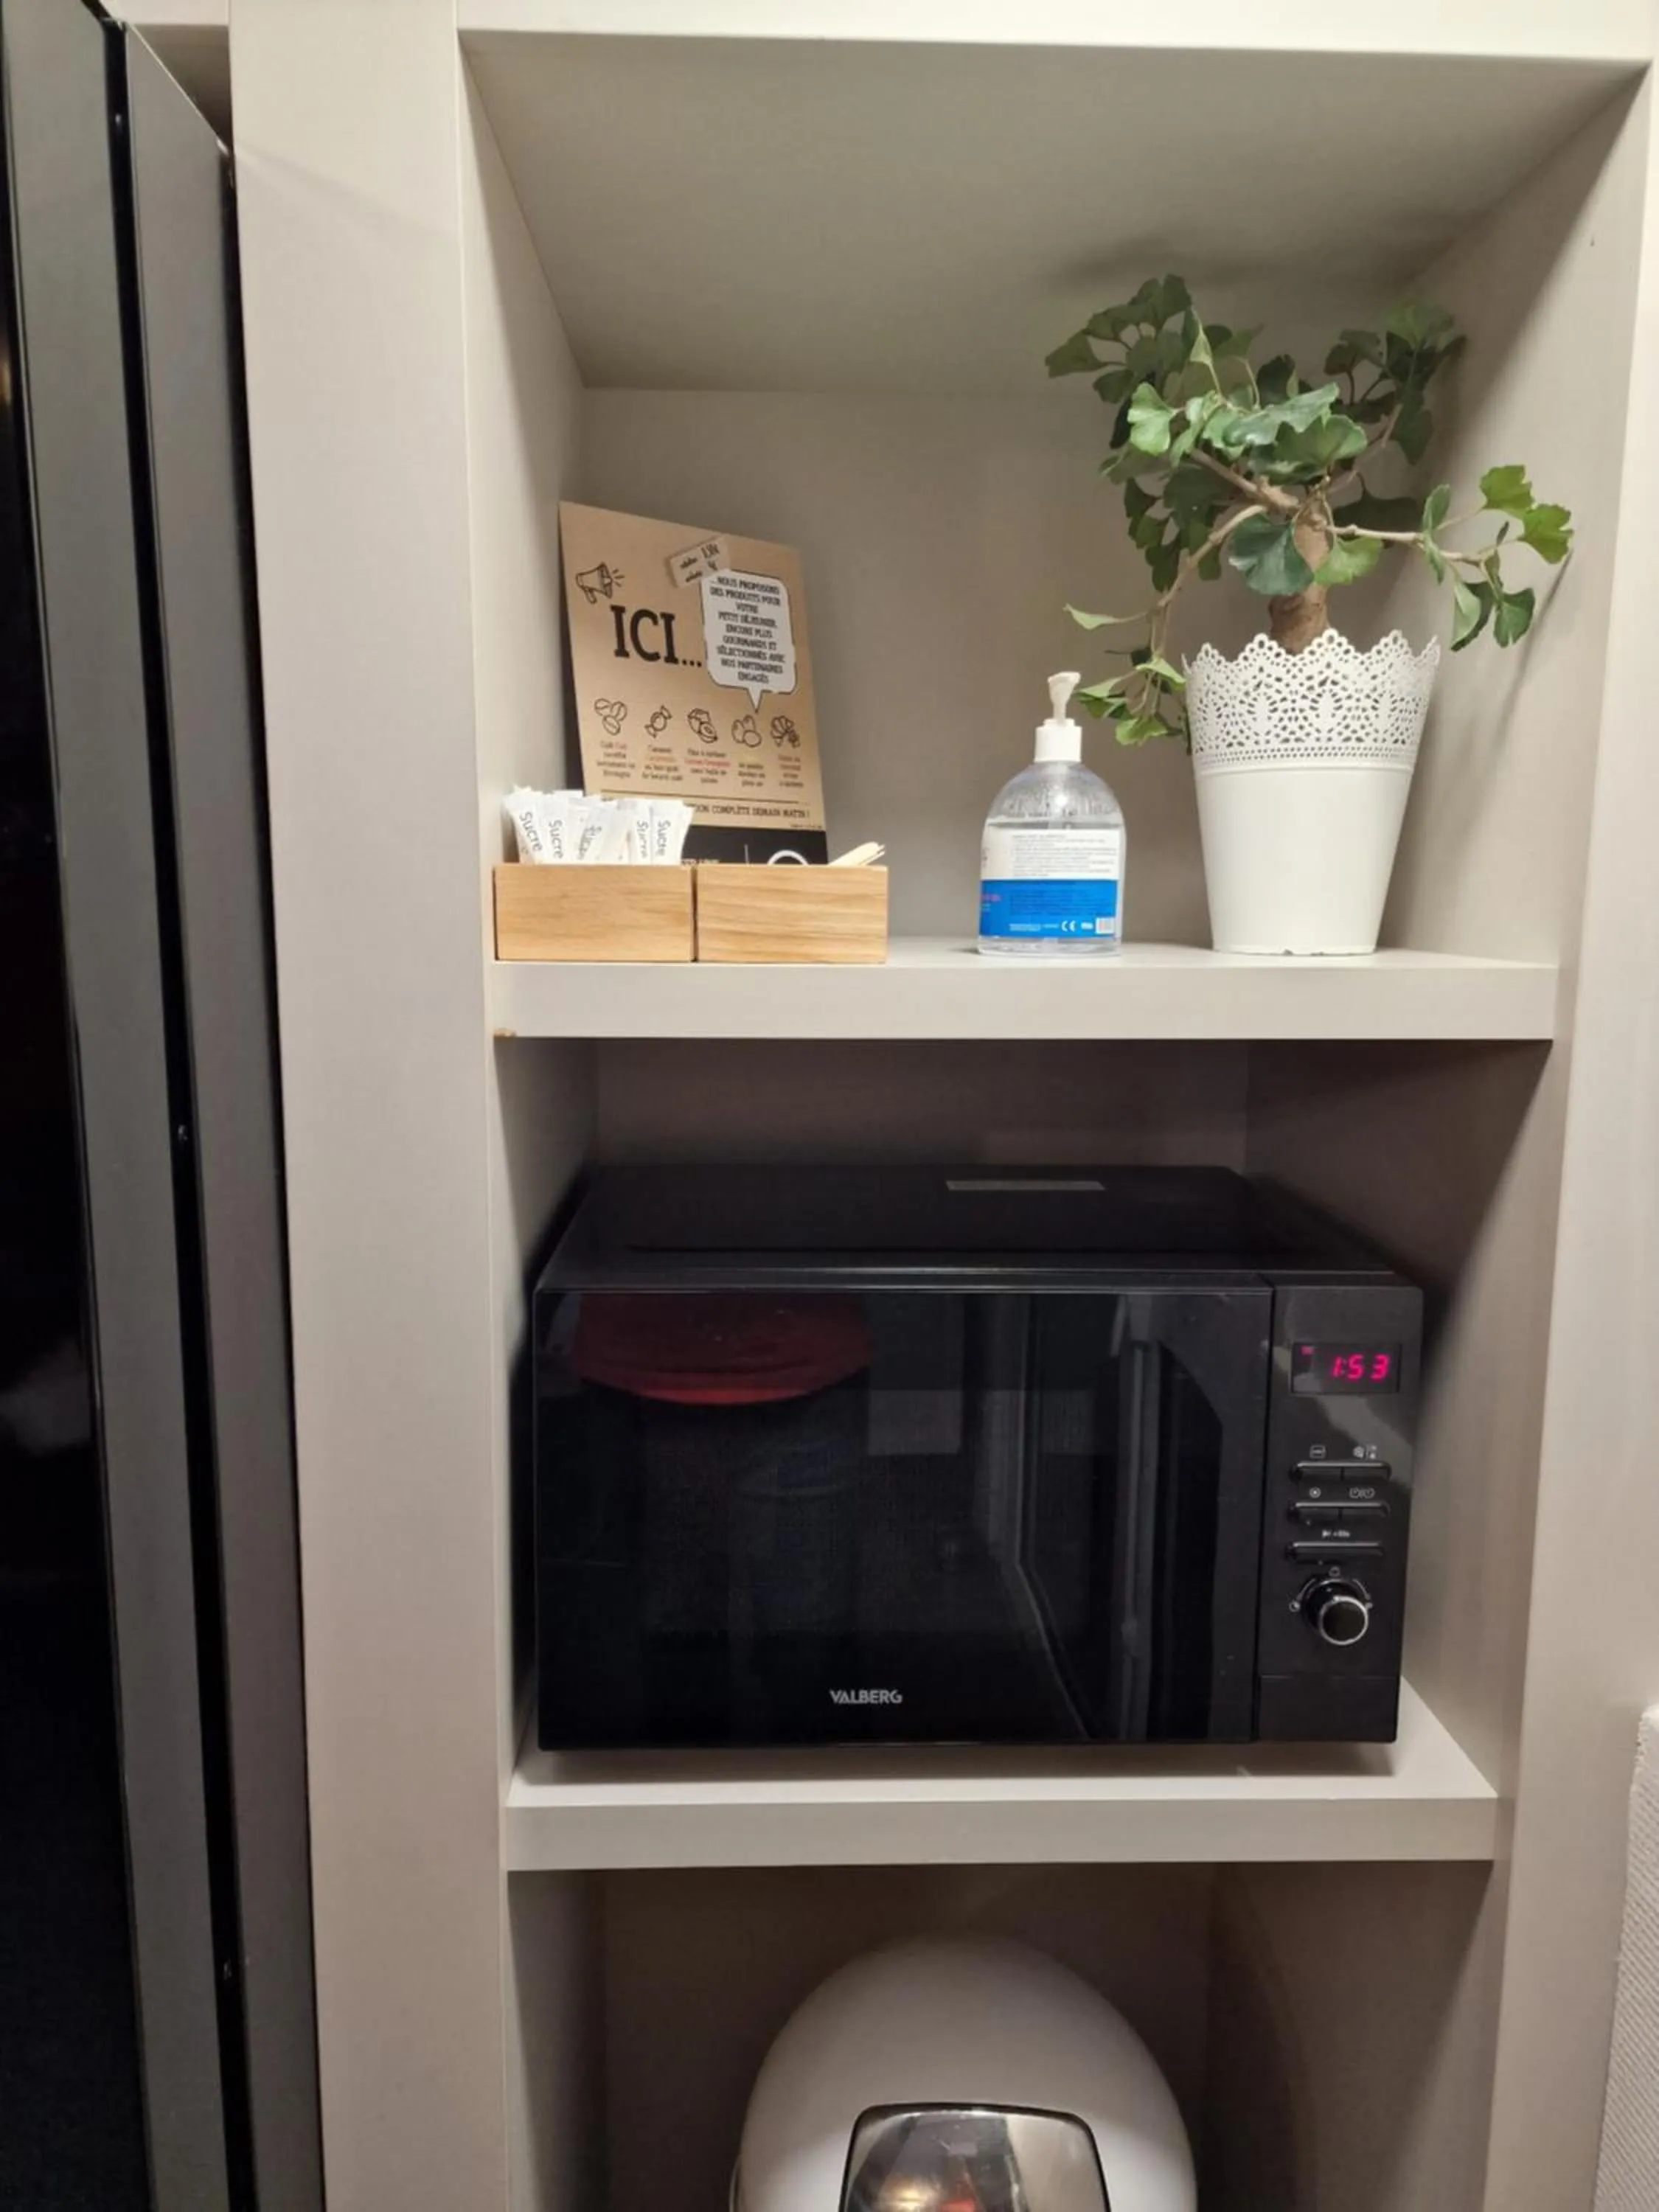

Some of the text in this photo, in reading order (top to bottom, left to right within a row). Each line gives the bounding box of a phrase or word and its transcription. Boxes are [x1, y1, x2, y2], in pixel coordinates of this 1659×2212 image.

[736, 602, 758, 613] VOTRE
[762, 595, 781, 605] POUR
[718, 611, 738, 622] PETIT
[611, 604, 702, 667] ICI...
[519, 812, 543, 852] Sucre
[549, 819, 563, 859] Sucre
[1331, 1354, 1391, 1381] 1:53
[829, 1688, 902, 1704] VALBERG
